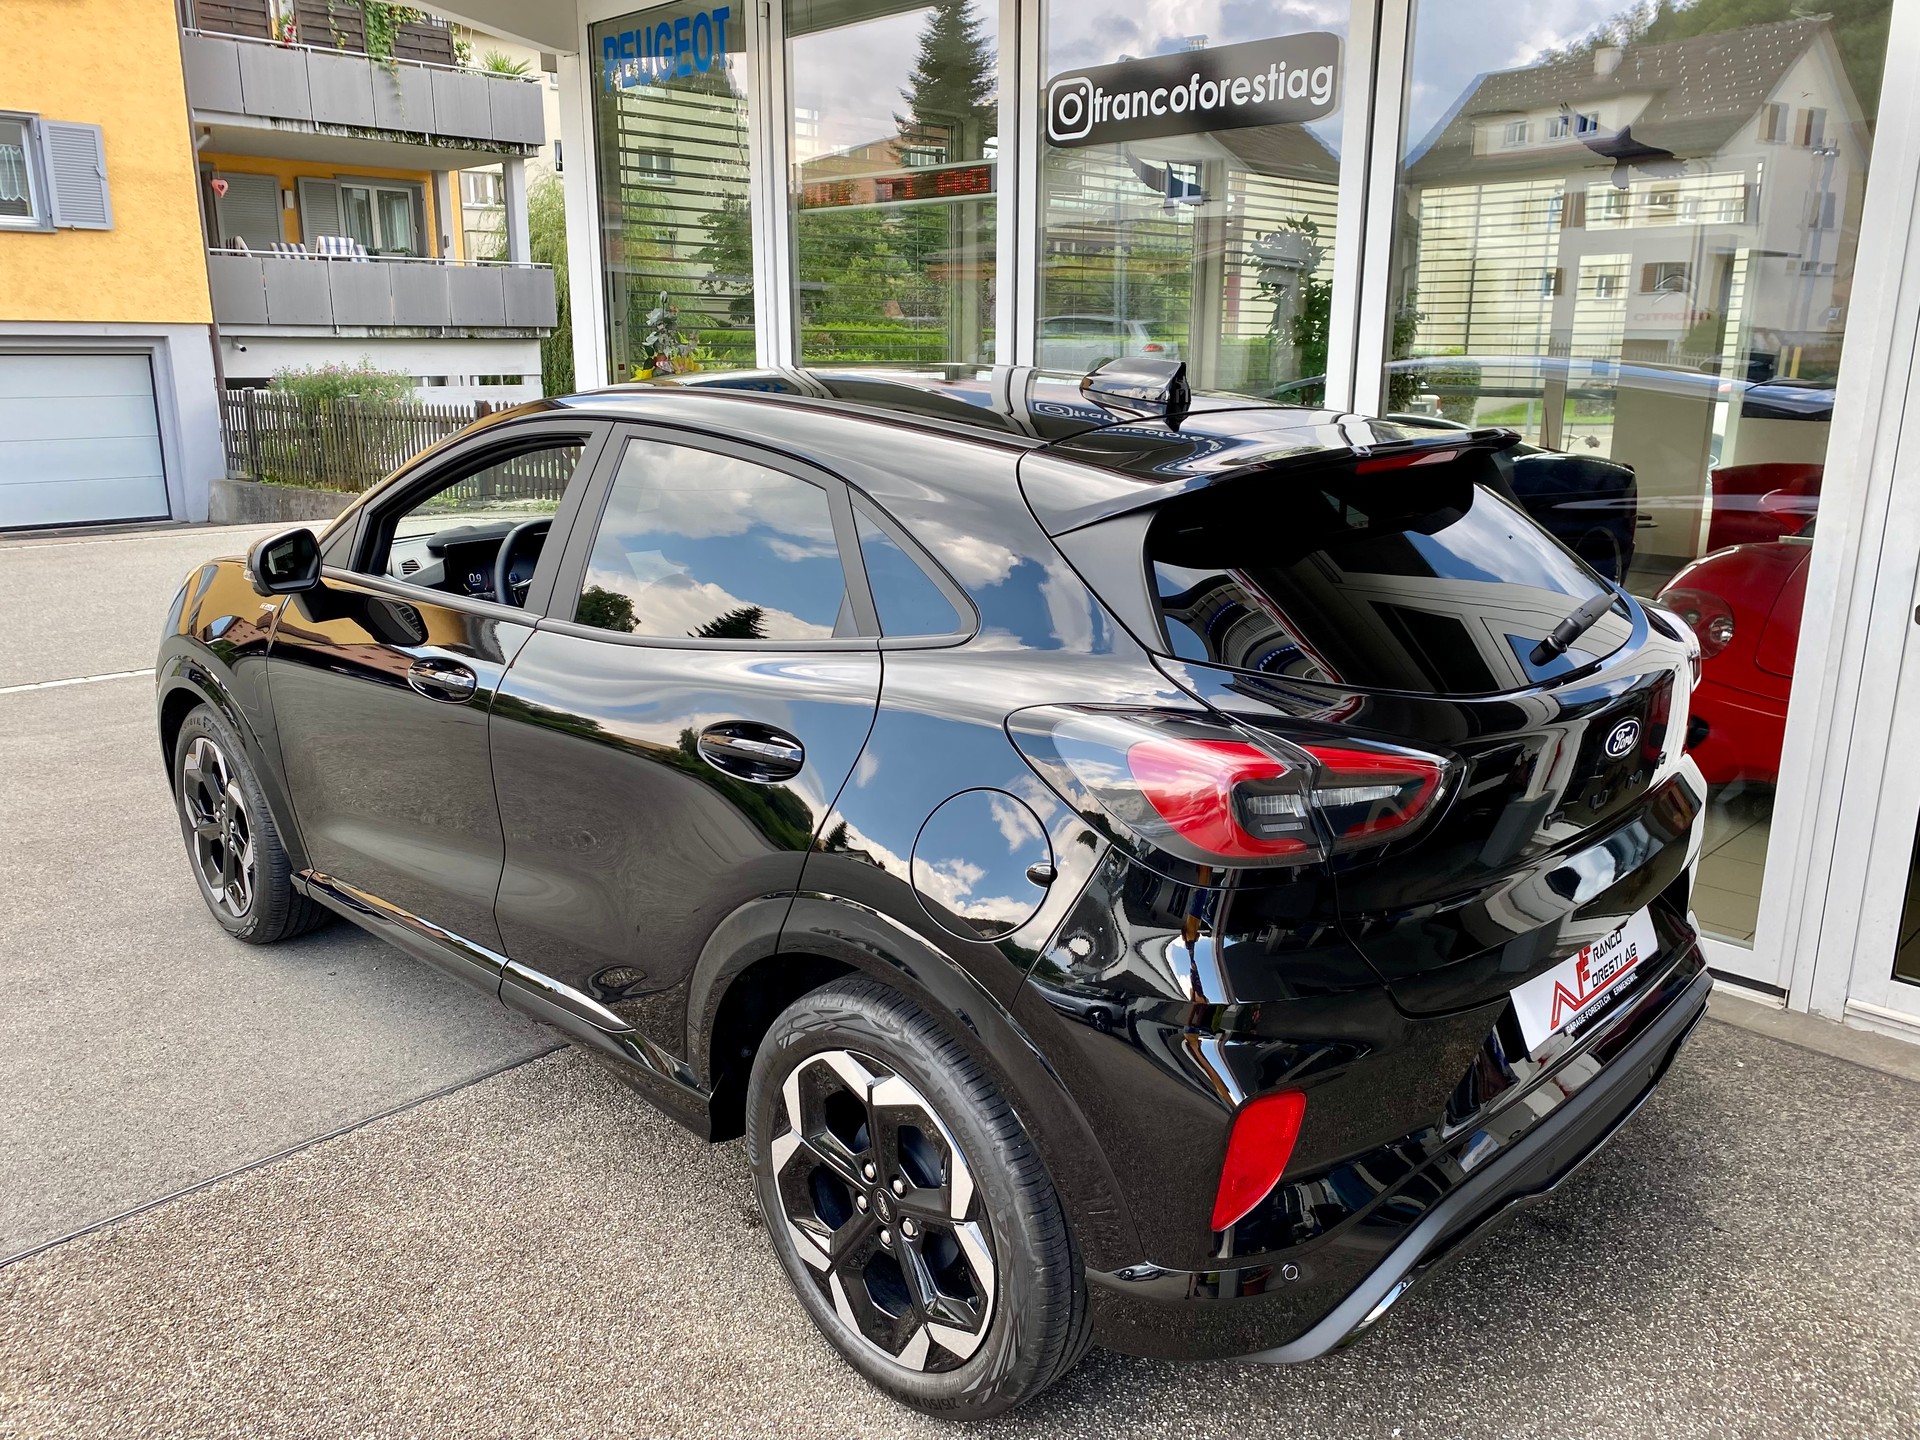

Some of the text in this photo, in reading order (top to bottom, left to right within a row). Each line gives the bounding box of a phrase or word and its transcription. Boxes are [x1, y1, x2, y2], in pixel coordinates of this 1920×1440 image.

[603, 6, 730, 93] PEUGEOT
[1093, 60, 1334, 123] francoforestiag
[937, 167, 989, 195] AG
[1612, 725, 1635, 753] Ford
[1624, 942, 1637, 963] AG
